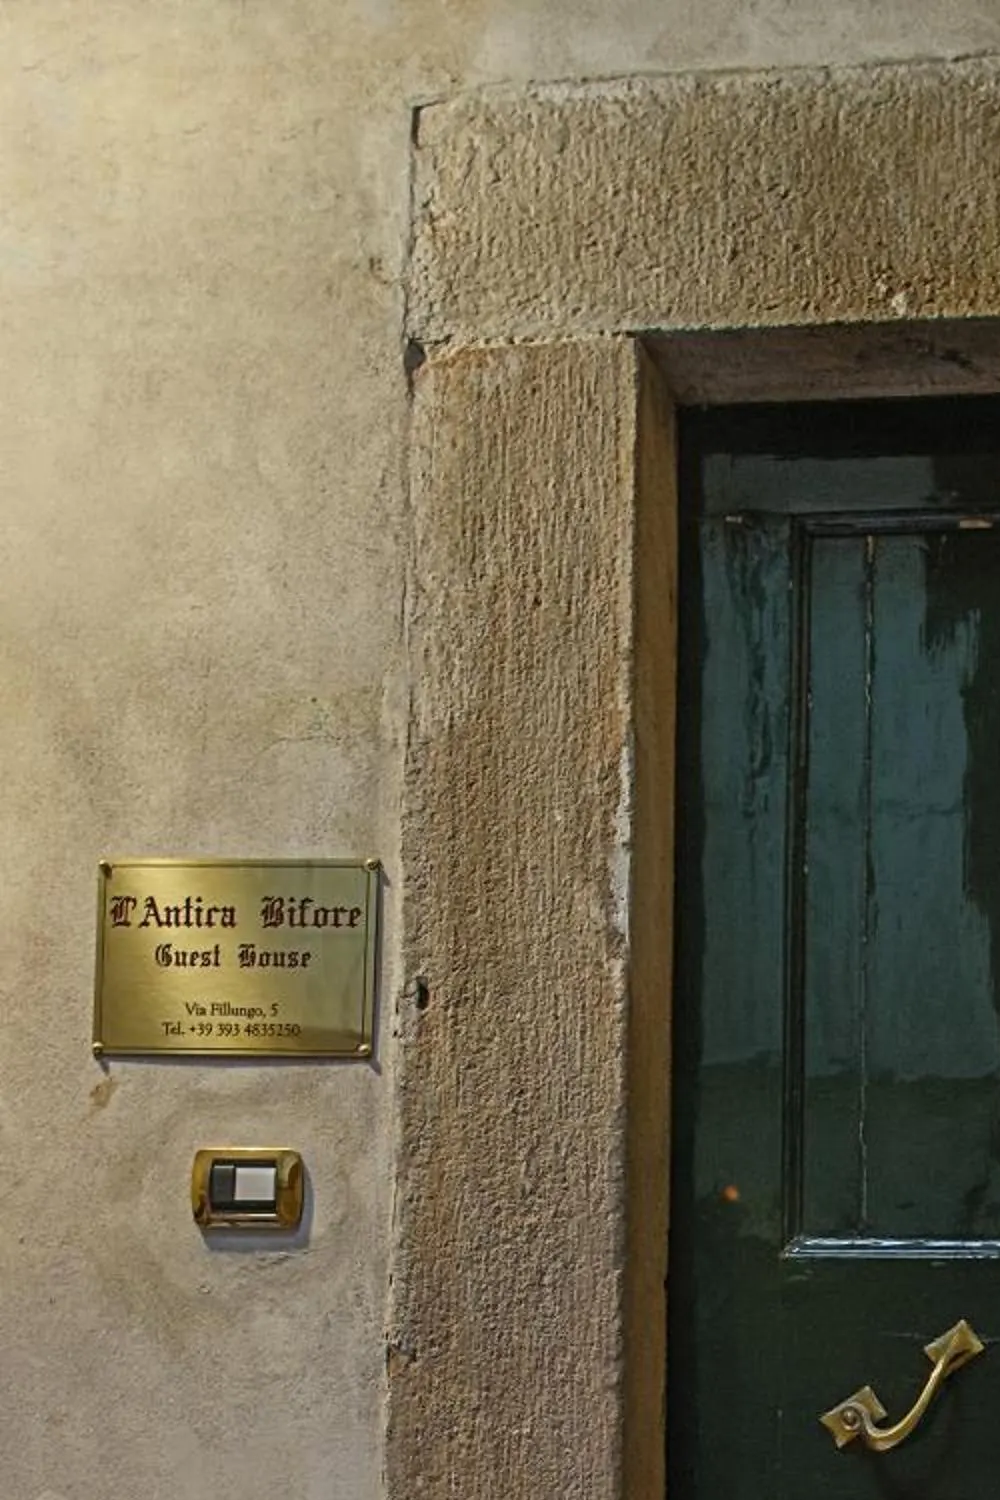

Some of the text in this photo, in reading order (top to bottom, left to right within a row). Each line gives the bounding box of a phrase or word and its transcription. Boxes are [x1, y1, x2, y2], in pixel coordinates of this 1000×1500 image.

[261, 895, 362, 929] Bifore
[155, 944, 312, 969] Guest House
[185, 1002, 280, 1019] Via Fillungo, 5
[161, 1021, 185, 1036] Tel.
[190, 1022, 213, 1036] +39
[218, 1023, 241, 1037] 393
